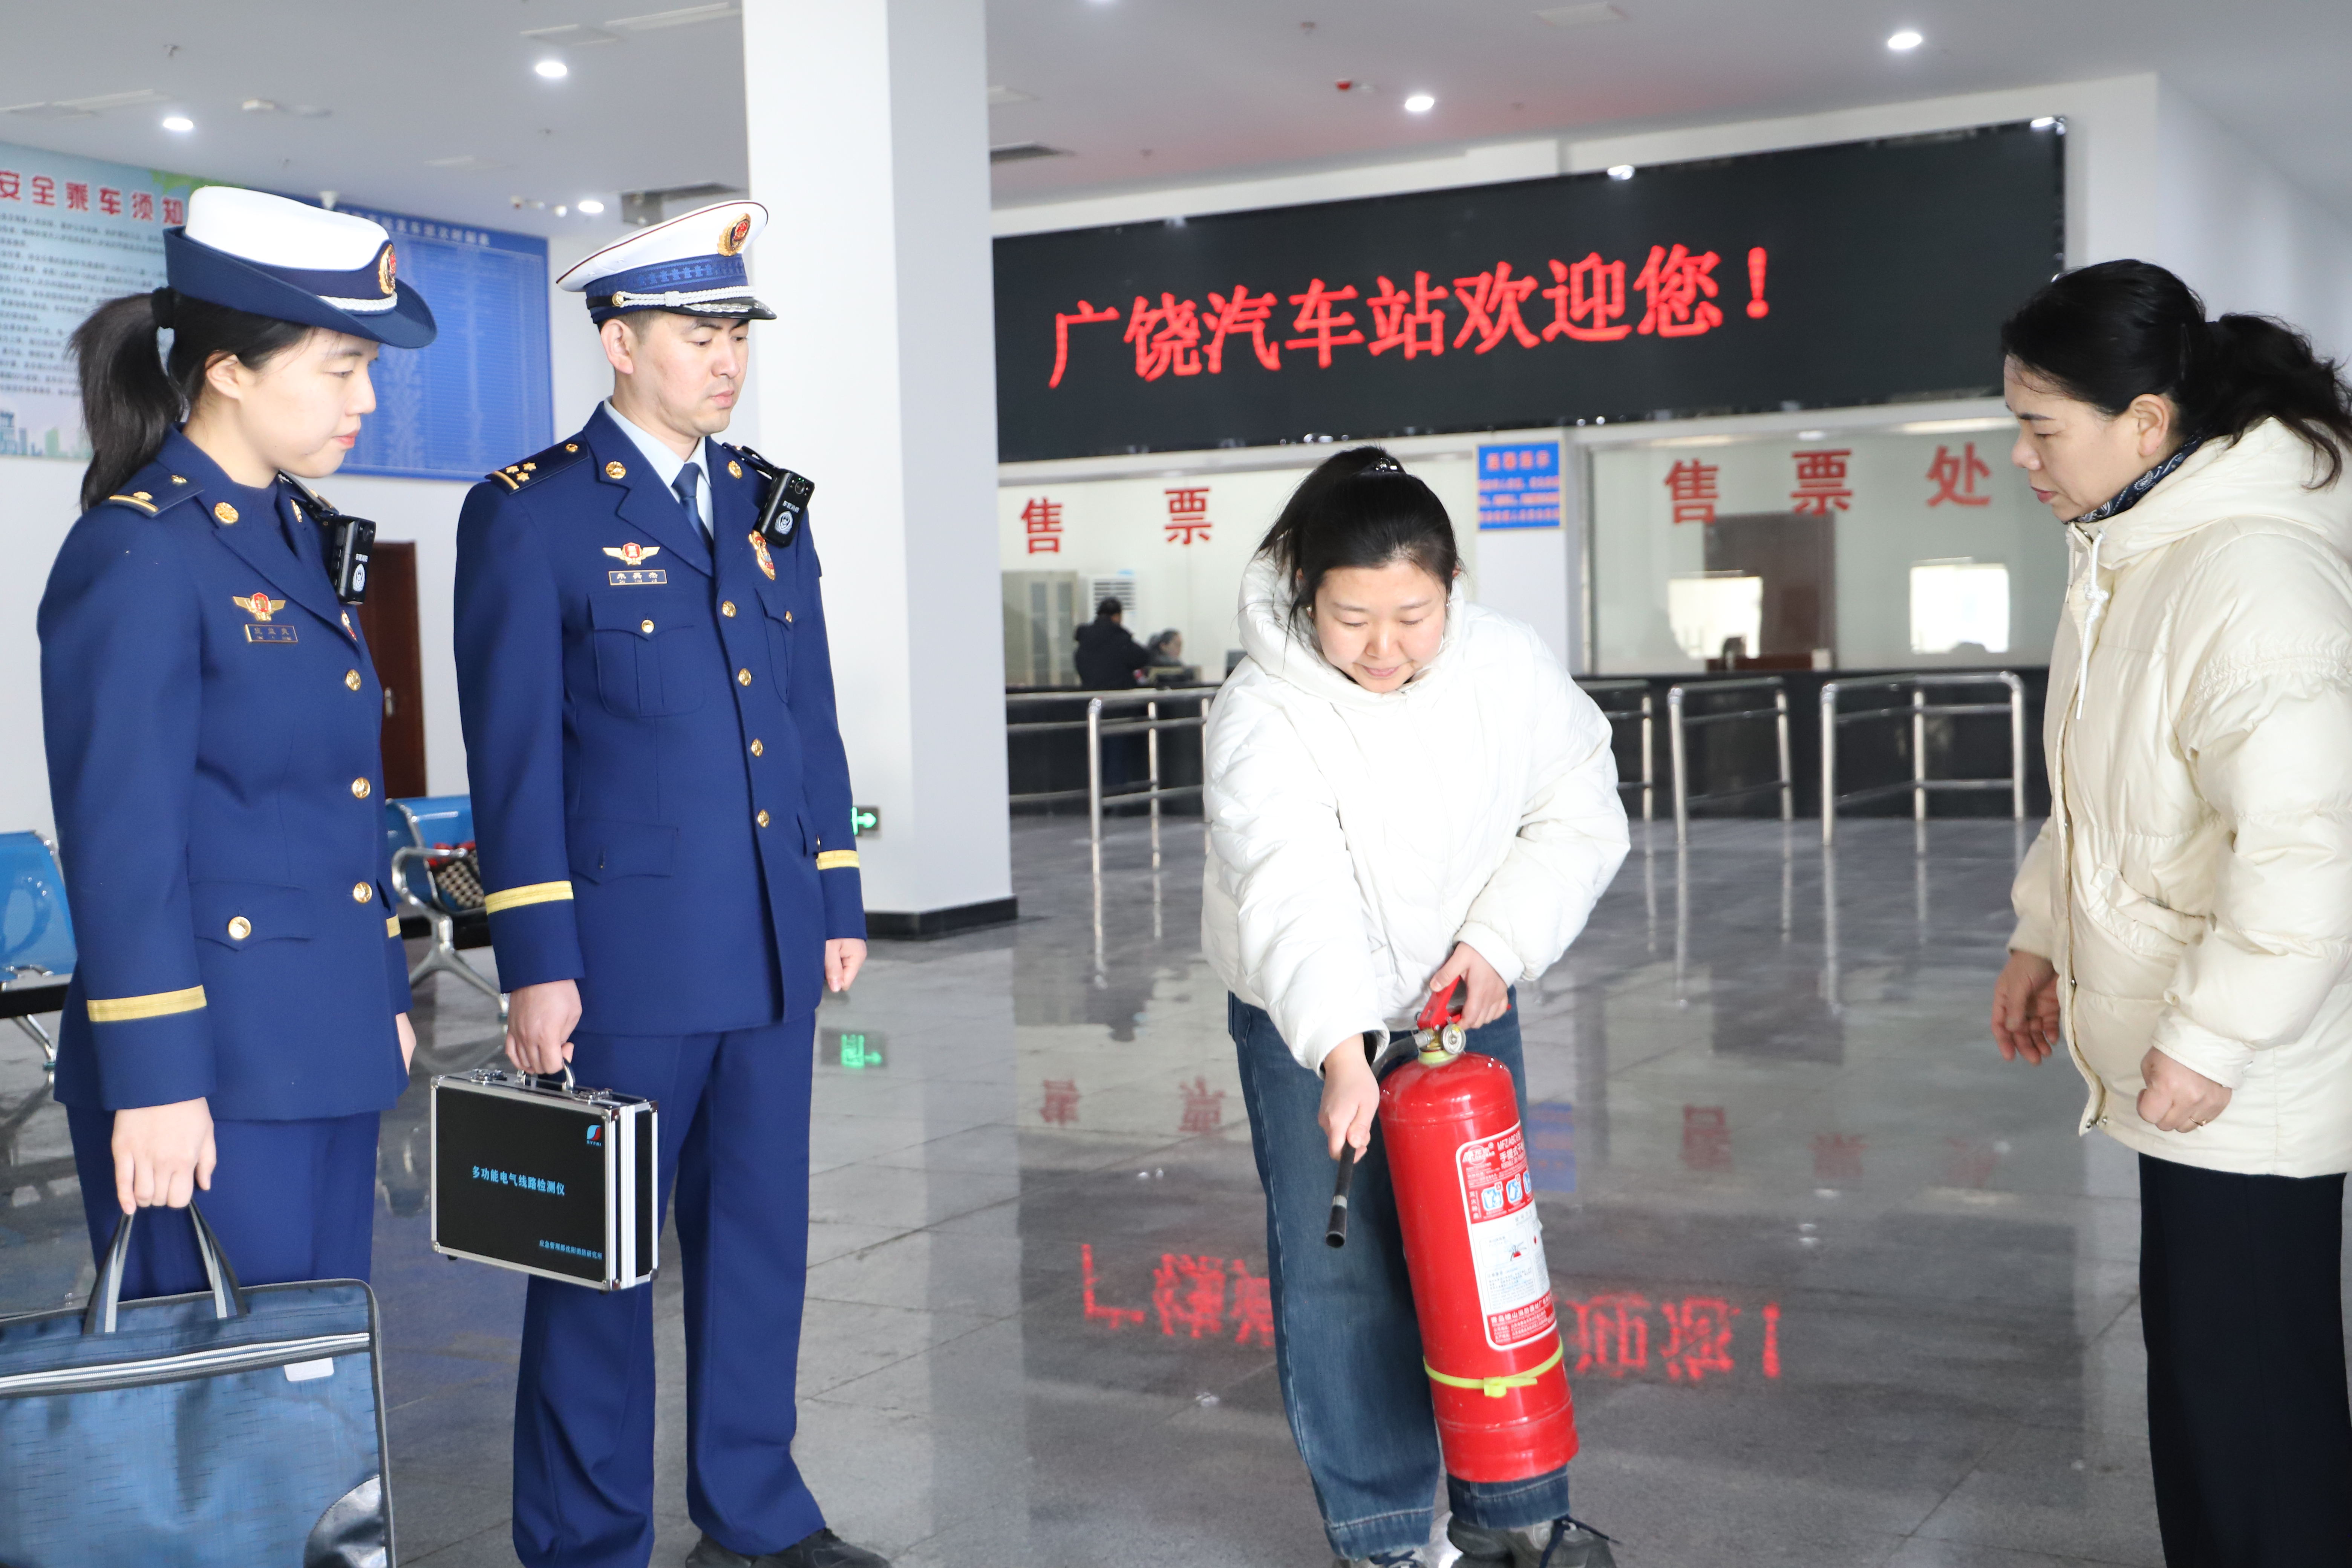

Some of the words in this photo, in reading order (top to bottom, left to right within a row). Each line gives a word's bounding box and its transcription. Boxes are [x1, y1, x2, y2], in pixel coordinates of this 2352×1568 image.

[0, 170, 184, 225] 安全乘车须知
[1049, 243, 1769, 388] 广饶汽车站欢迎您！
[1664, 443, 1991, 524] 售票处
[1021, 487, 1213, 554] 售票
[472, 1165, 565, 1196] 多功能电气线路检测仪
